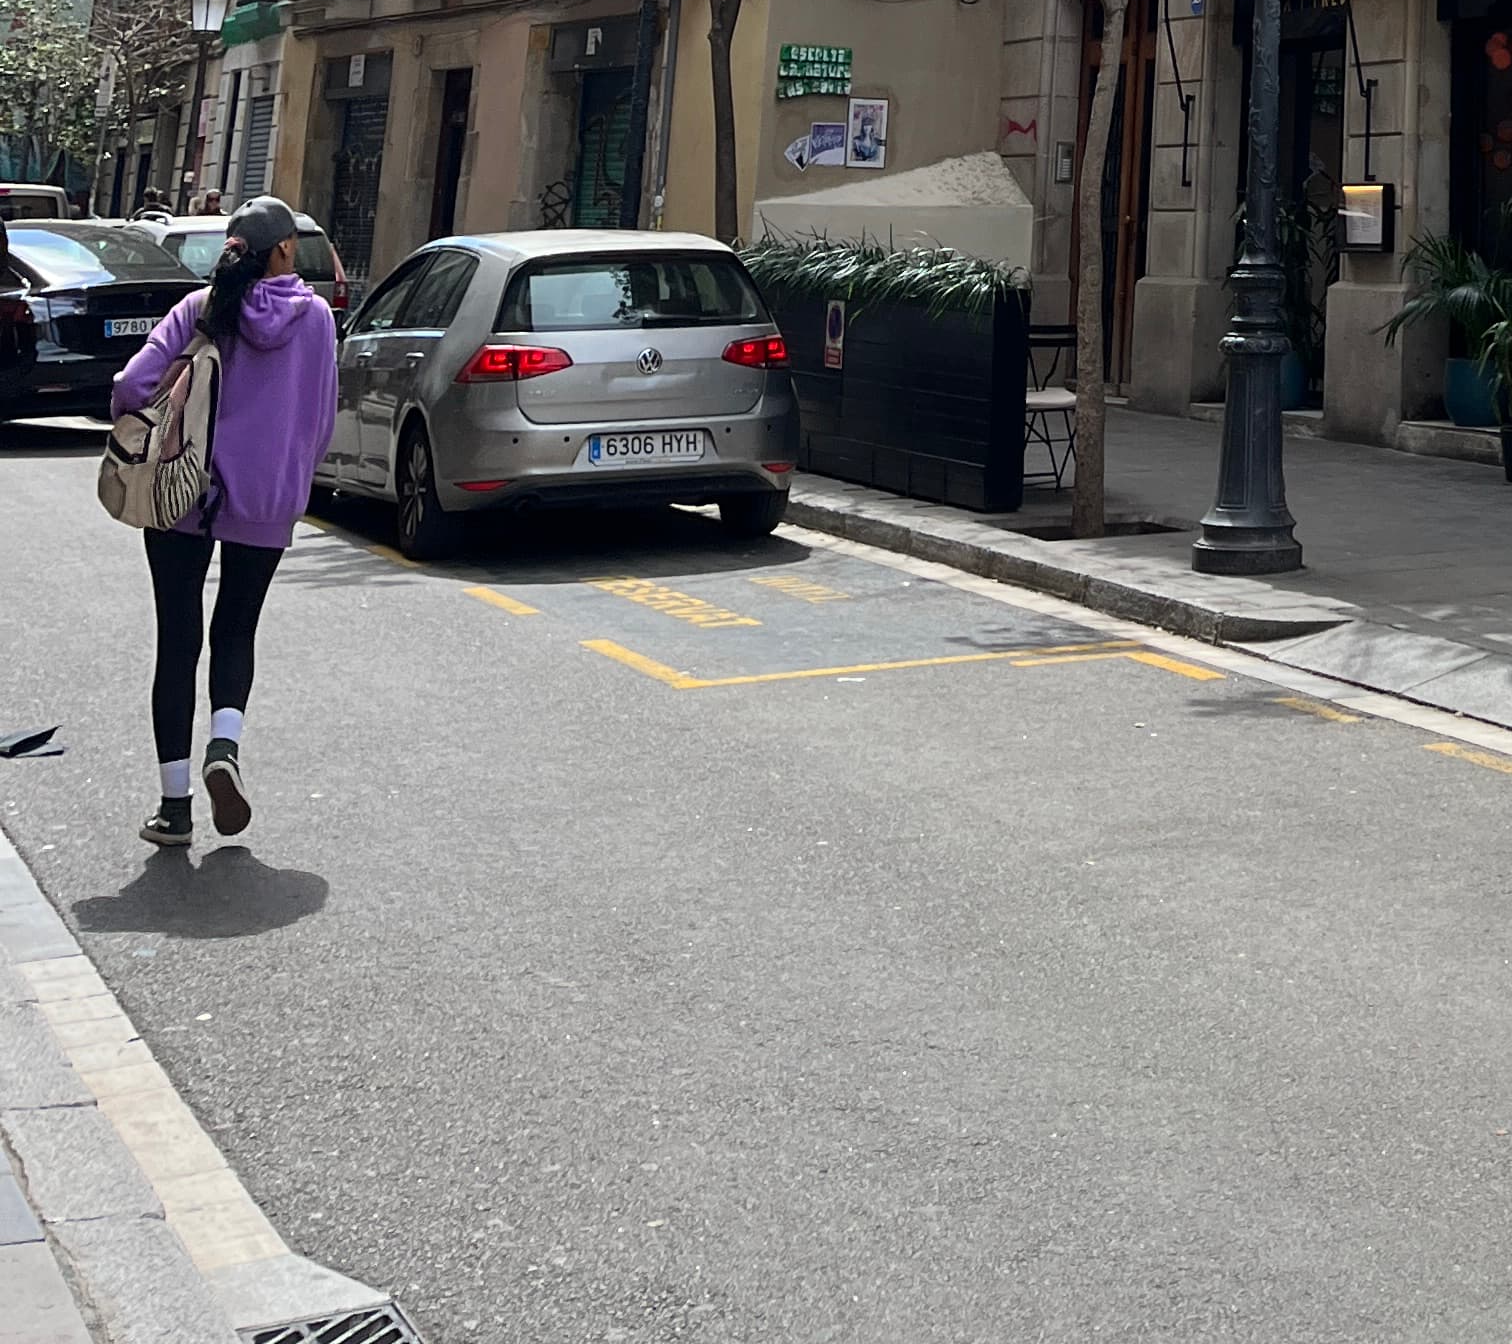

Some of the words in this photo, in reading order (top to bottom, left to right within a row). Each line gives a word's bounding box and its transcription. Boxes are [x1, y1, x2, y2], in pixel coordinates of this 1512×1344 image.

[113, 320, 147, 334] 9780
[606, 436, 654, 456] 6306
[662, 433, 697, 453] HYH
